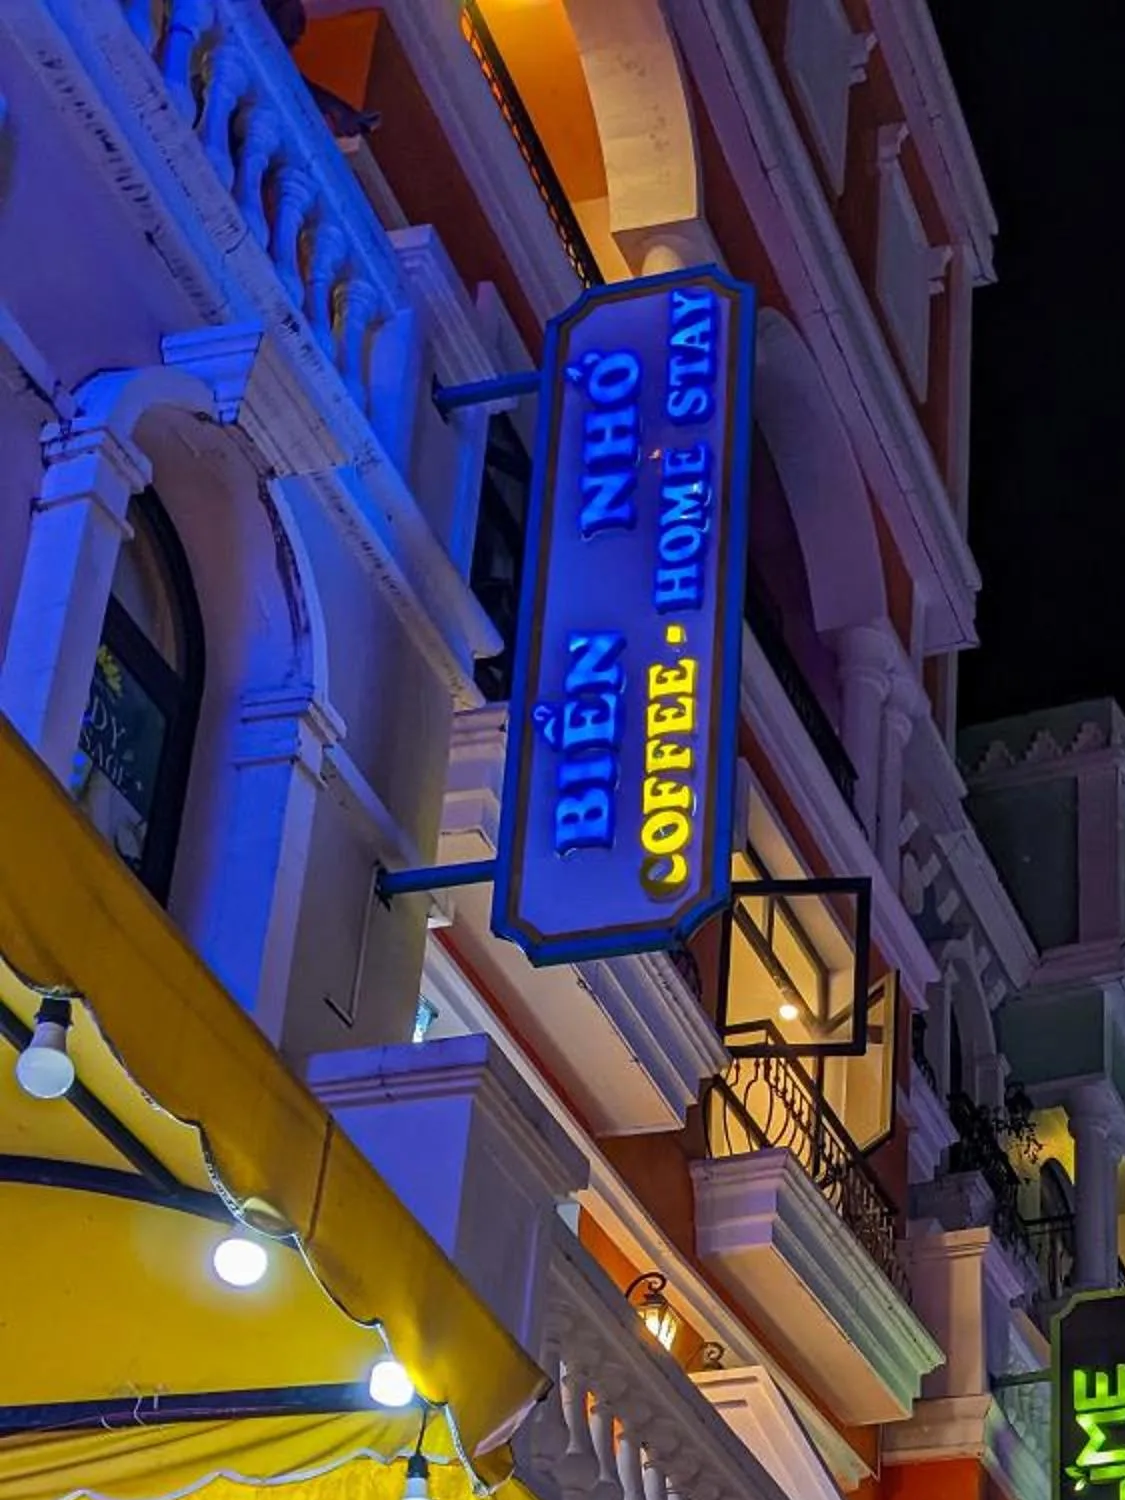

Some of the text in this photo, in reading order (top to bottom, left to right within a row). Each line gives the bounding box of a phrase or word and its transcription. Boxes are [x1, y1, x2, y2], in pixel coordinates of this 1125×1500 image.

[532, 350, 641, 857] BIỂN NHỚ
[640, 287, 717, 896] COFFEE HOME STAY
